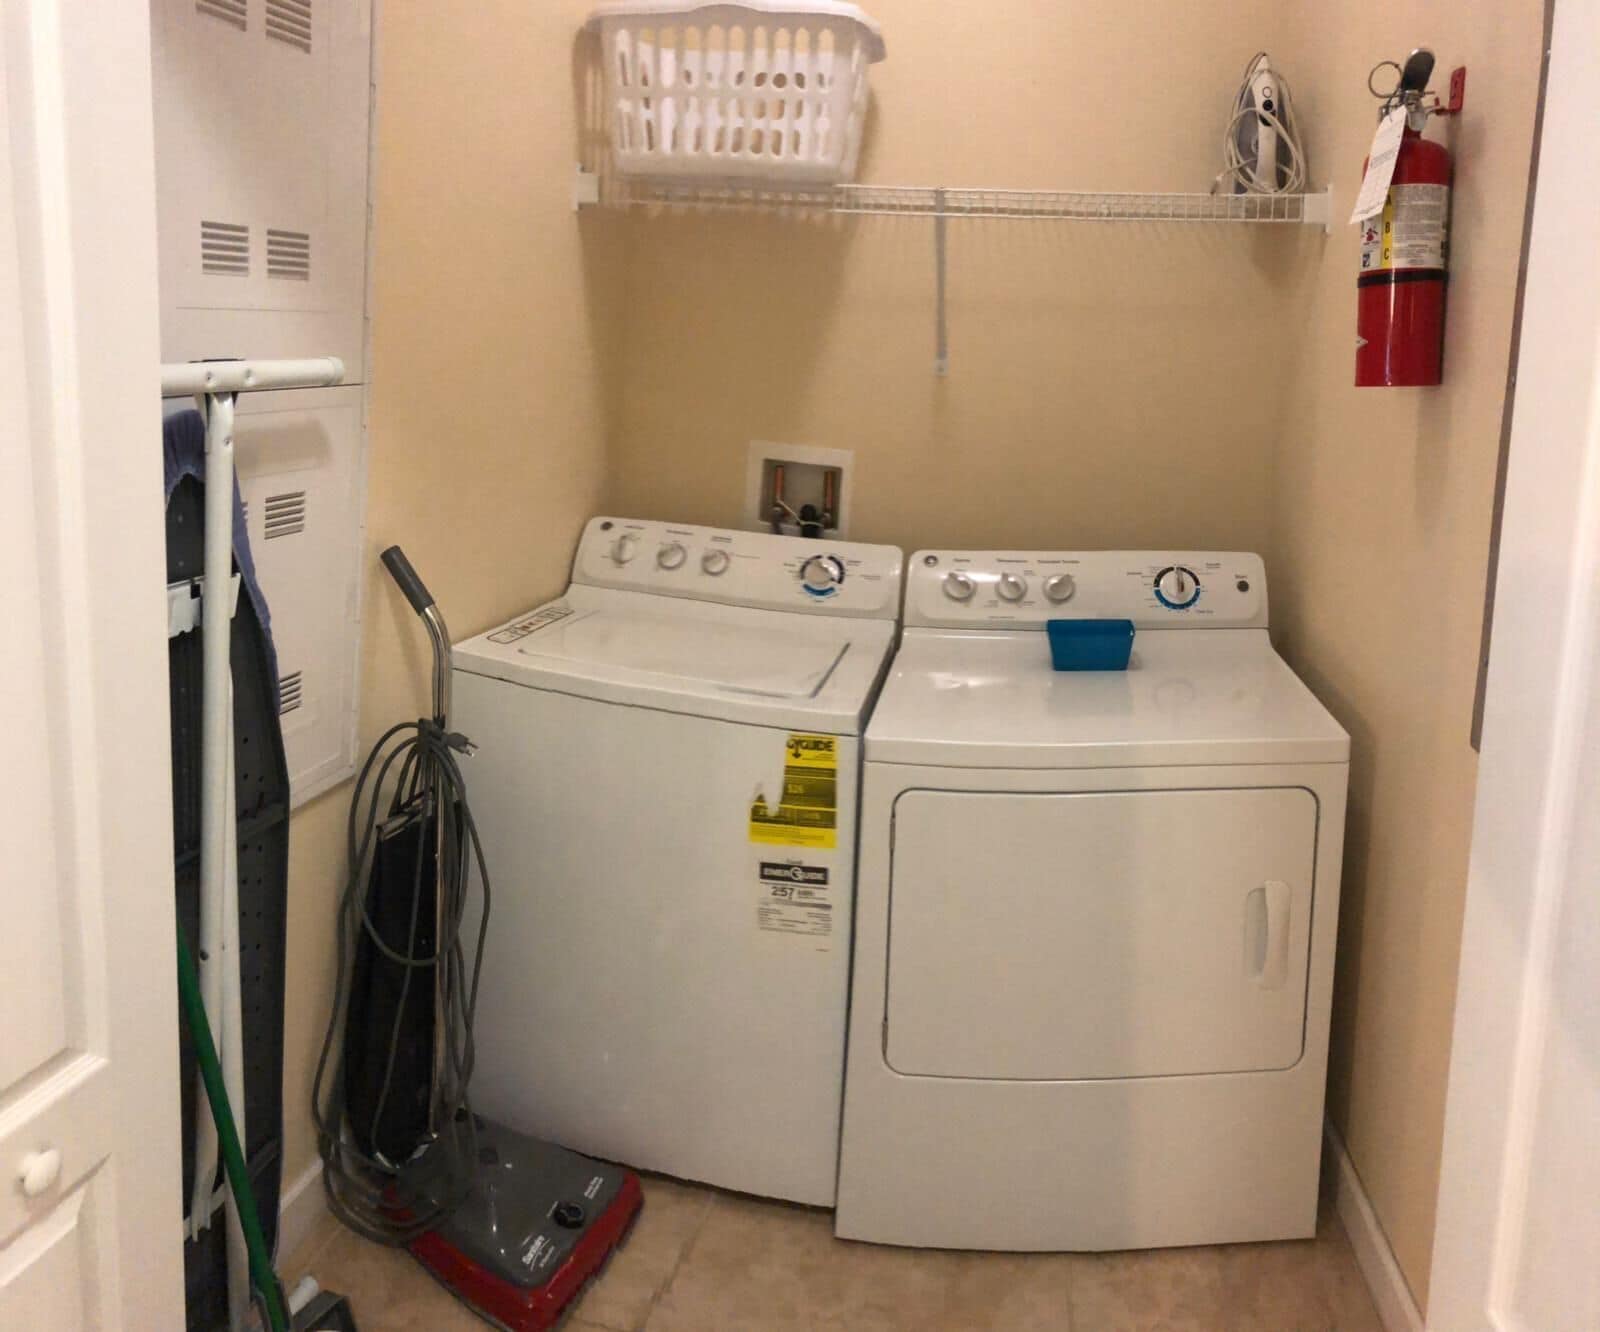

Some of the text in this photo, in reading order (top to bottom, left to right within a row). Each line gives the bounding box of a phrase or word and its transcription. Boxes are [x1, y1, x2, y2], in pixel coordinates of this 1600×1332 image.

[1385, 222, 1391, 234] B
[1384, 248, 1390, 260] C
[771, 886, 794, 900] 257
